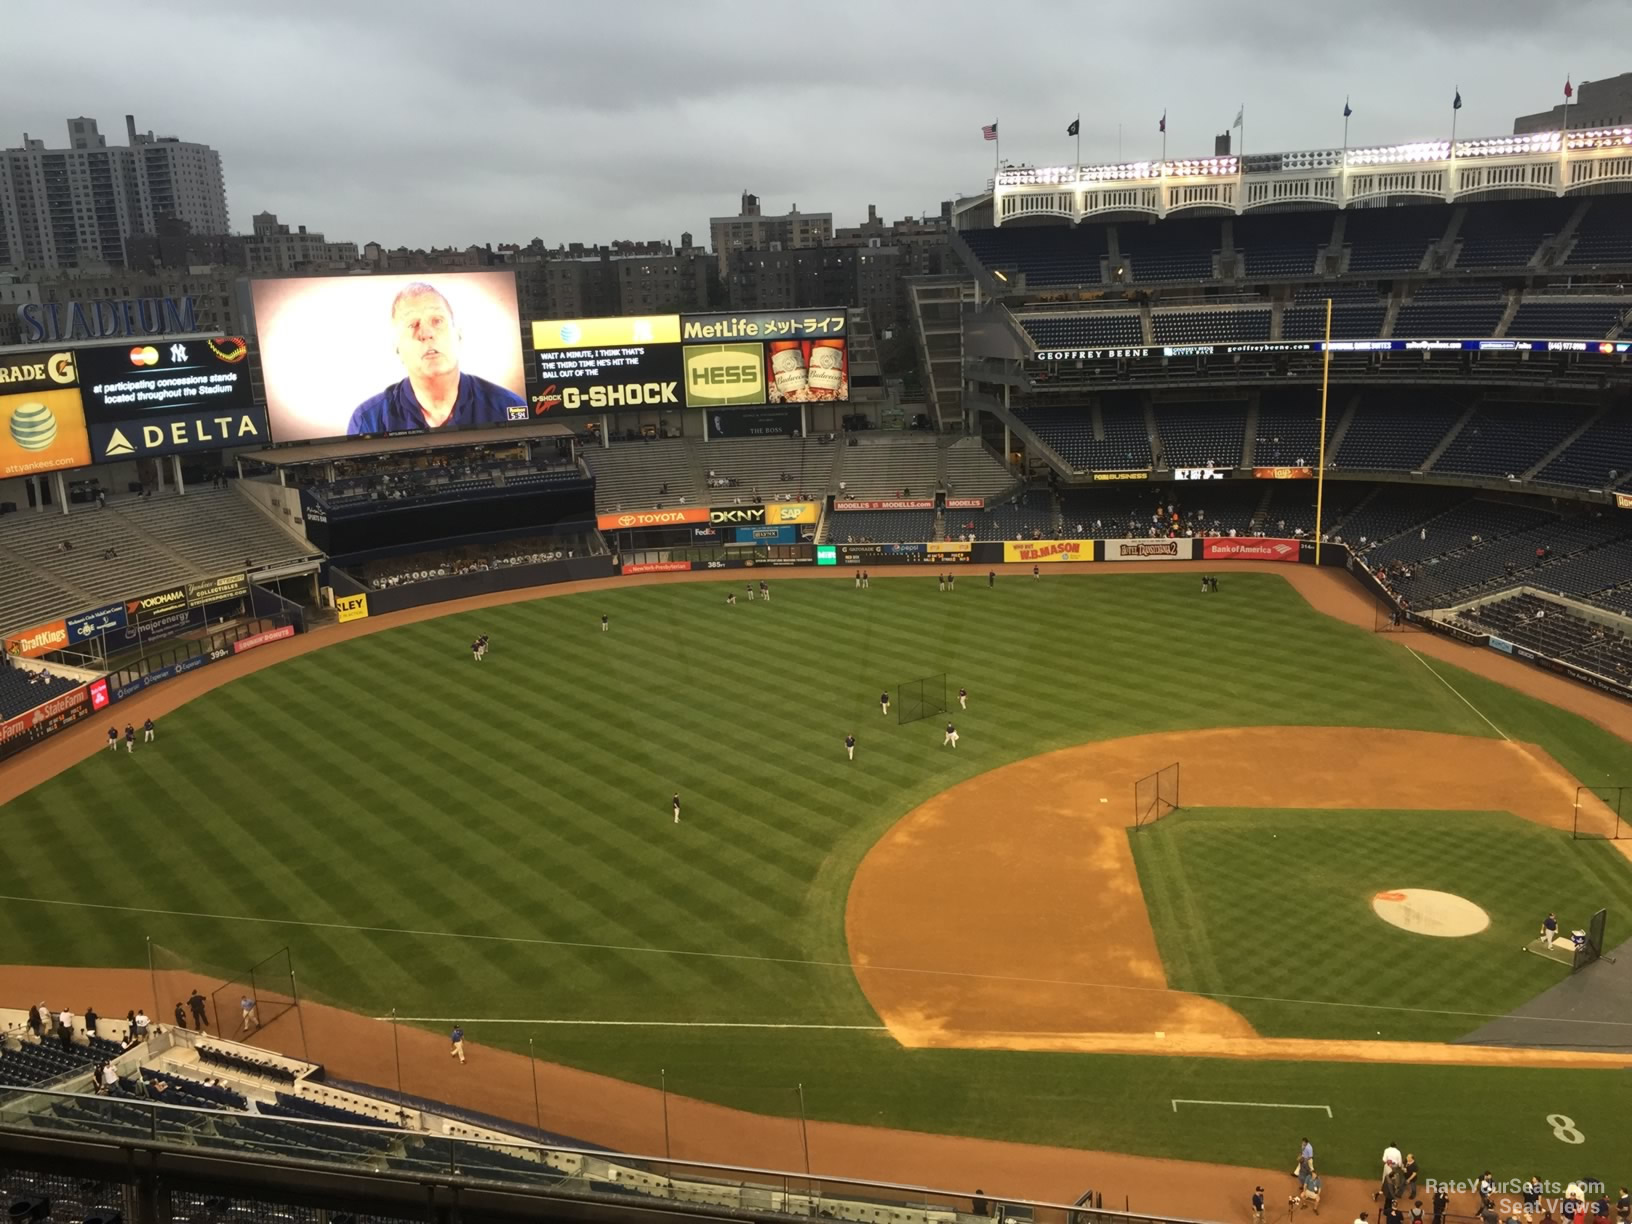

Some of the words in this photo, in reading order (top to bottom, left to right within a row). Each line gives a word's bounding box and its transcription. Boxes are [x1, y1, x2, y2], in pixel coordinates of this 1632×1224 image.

[17, 297, 198, 341] STADIUM
[764, 317, 845, 334] メットライフ
[684, 318, 759, 339] MetLife
[541, 351, 558, 360] WAIT
[560, 351, 565, 359] A
[566, 349, 594, 359] MINUTE,
[599, 349, 621, 357] THINK
[621, 347, 645, 355] THAT'S
[1037, 351, 1103, 361] GEOFFREY
[1108, 349, 1149, 359] BEENE
[1227, 344, 1310, 353] geoffreybeene.com
[542, 362, 556, 370] THE
[556, 361, 577, 369] THIRD
[579, 360, 595, 368] TIME
[596, 359, 612, 367] HE'S
[612, 358, 624, 366] HIT
[625, 357, 639, 365] THE
[543, 370, 558, 378] BALL
[575, 369, 584, 377] OF
[584, 368, 599, 376] THE
[692, 365, 758, 385] HESS
[93, 384, 103, 393] at
[103, 380, 155, 394] participating
[157, 375, 208, 388] concessions
[209, 372, 237, 382] stands
[104, 392, 135, 404] located
[137, 389, 182, 402] throughout
[183, 387, 197, 396] the
[198, 384, 233, 395] Stadium
[532, 394, 562, 402] G-SHOCK
[562, 381, 679, 409] G-SHOCK
[143, 415, 258, 448] DELTA
[5, 456, 75, 474] att.yankees.com
[638, 512, 685, 523] TOYOTA
[711, 509, 764, 523] DKNY
[781, 509, 801, 520] SAP
[695, 528, 716, 536] FedEx
[1170, 541, 1178, 556] 2
[1211, 545, 1231, 553] Bank
[1231, 545, 1240, 553] of
[1239, 545, 1272, 554] America
[196, 582, 239, 597] COLLECTIBLES
[141, 590, 184, 609] YOKOHAMA
[21, 629, 66, 652] DraftKings
[264, 629, 290, 642] DONUTS
[1546, 1114, 1585, 1144] 8
